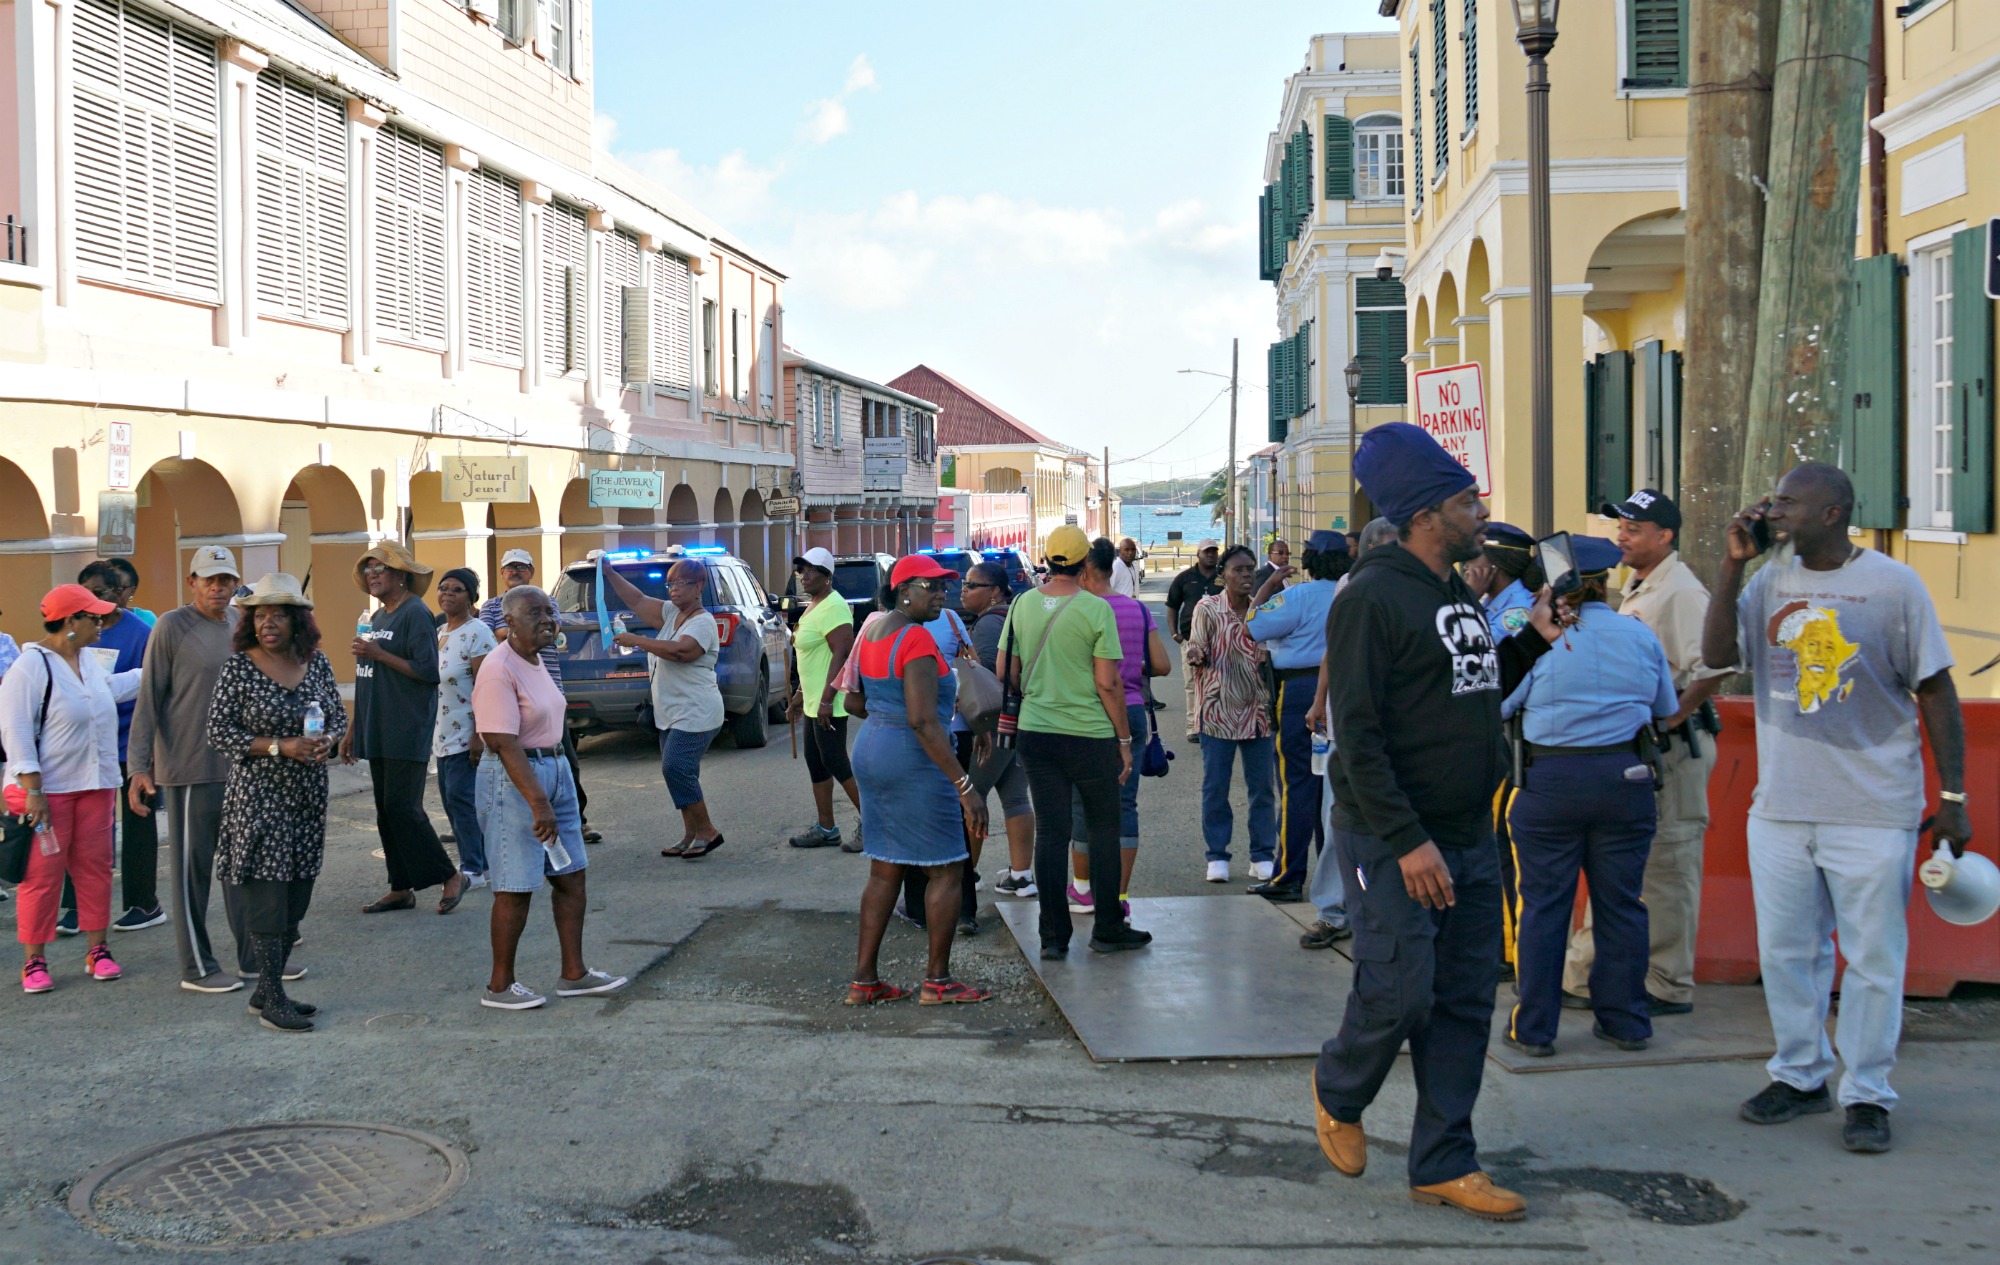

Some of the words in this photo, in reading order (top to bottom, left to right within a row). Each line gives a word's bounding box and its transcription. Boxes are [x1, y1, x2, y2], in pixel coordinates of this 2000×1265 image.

[1438, 382, 1460, 407] NO
[1423, 407, 1481, 436] PARKING
[116, 429, 125, 441] NO
[110, 443, 130, 456] PARKING
[1442, 435, 1467, 452] ANY
[1451, 453, 1470, 468] ME
[454, 462, 516, 481] Natural
[463, 481, 507, 497] Jewel
[596, 476, 613, 485] THE
[613, 477, 655, 489] JEWELRY
[607, 488, 643, 499] FACTORY
[1625, 491, 1657, 510] LICE
